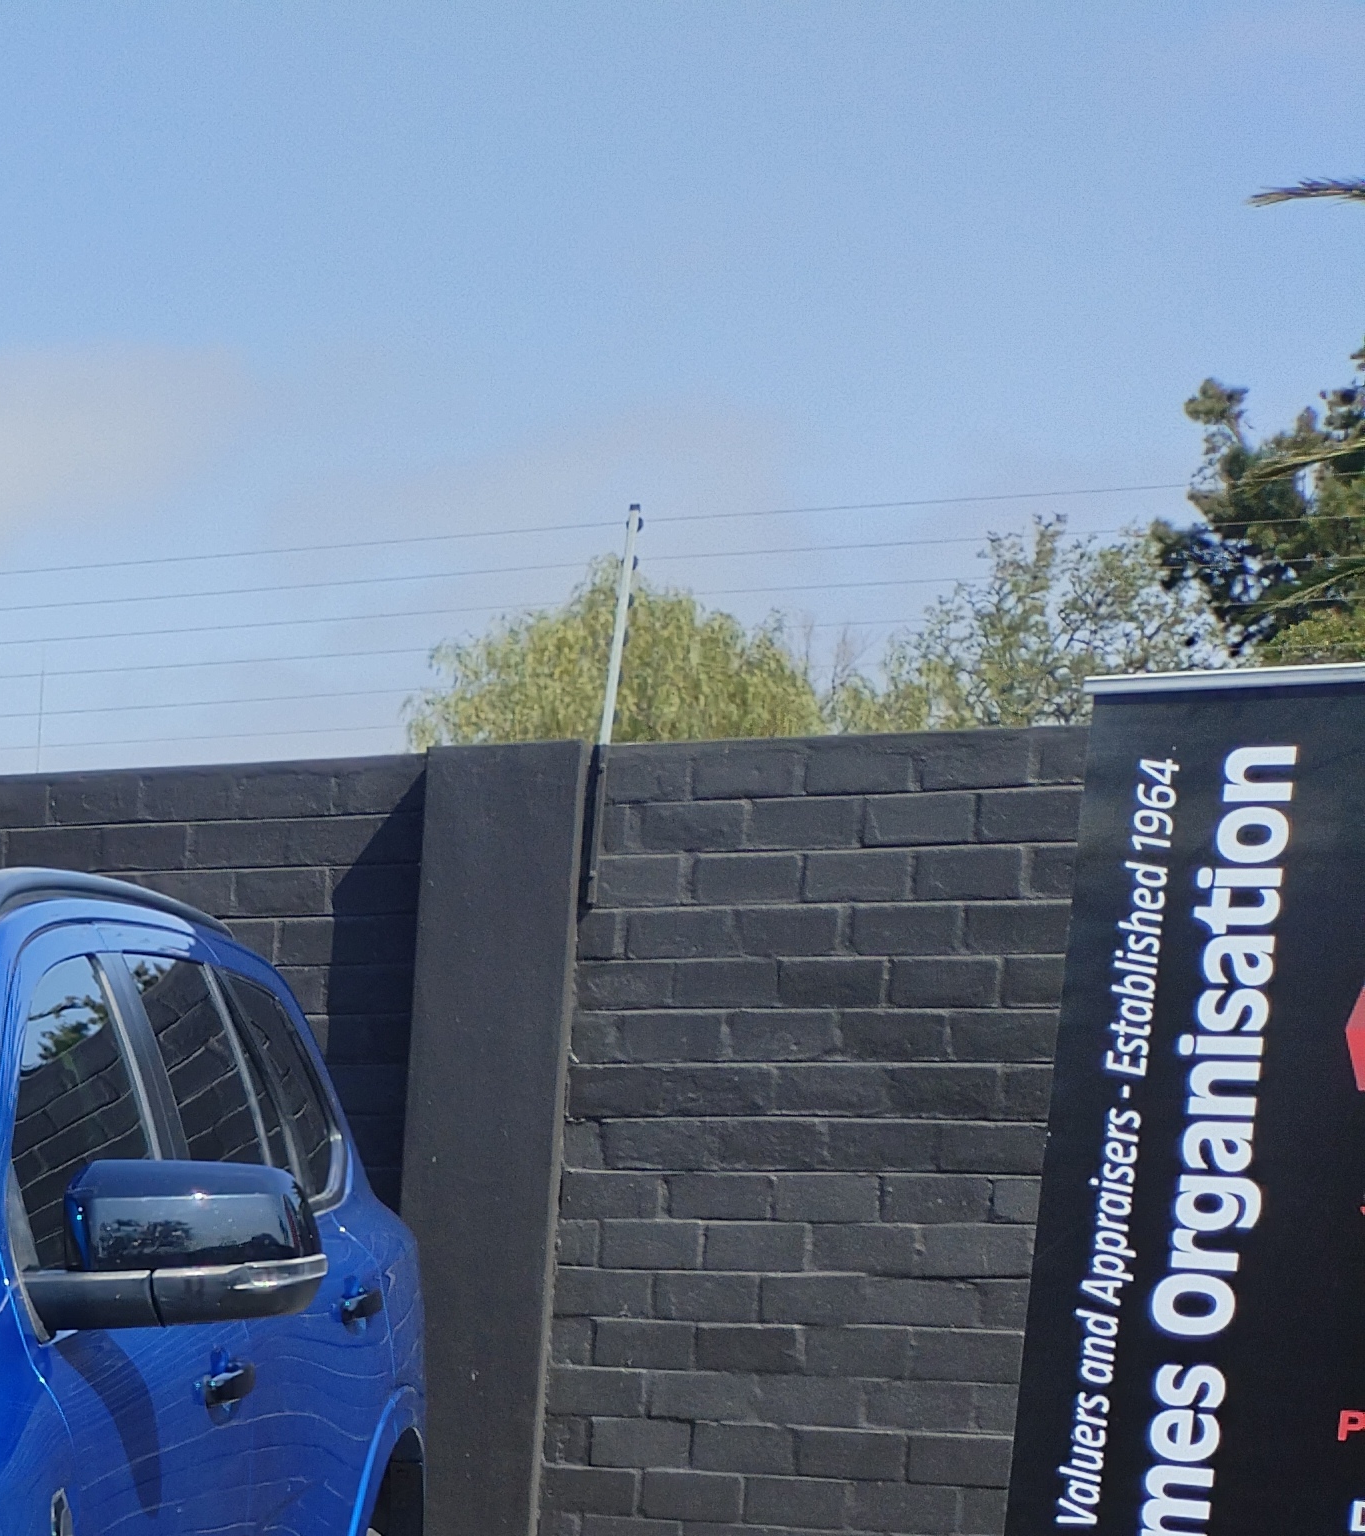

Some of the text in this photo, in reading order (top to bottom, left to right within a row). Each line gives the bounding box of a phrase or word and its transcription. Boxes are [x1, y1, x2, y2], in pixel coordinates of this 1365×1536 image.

[1132, 756, 1181, 849] 1964
[1105, 859, 1169, 1078] Established
[1080, 1106, 1141, 1307] Appraisers
[1075, 1307, 1120, 1384] and
[1055, 1391, 1111, 1527] Valuers
